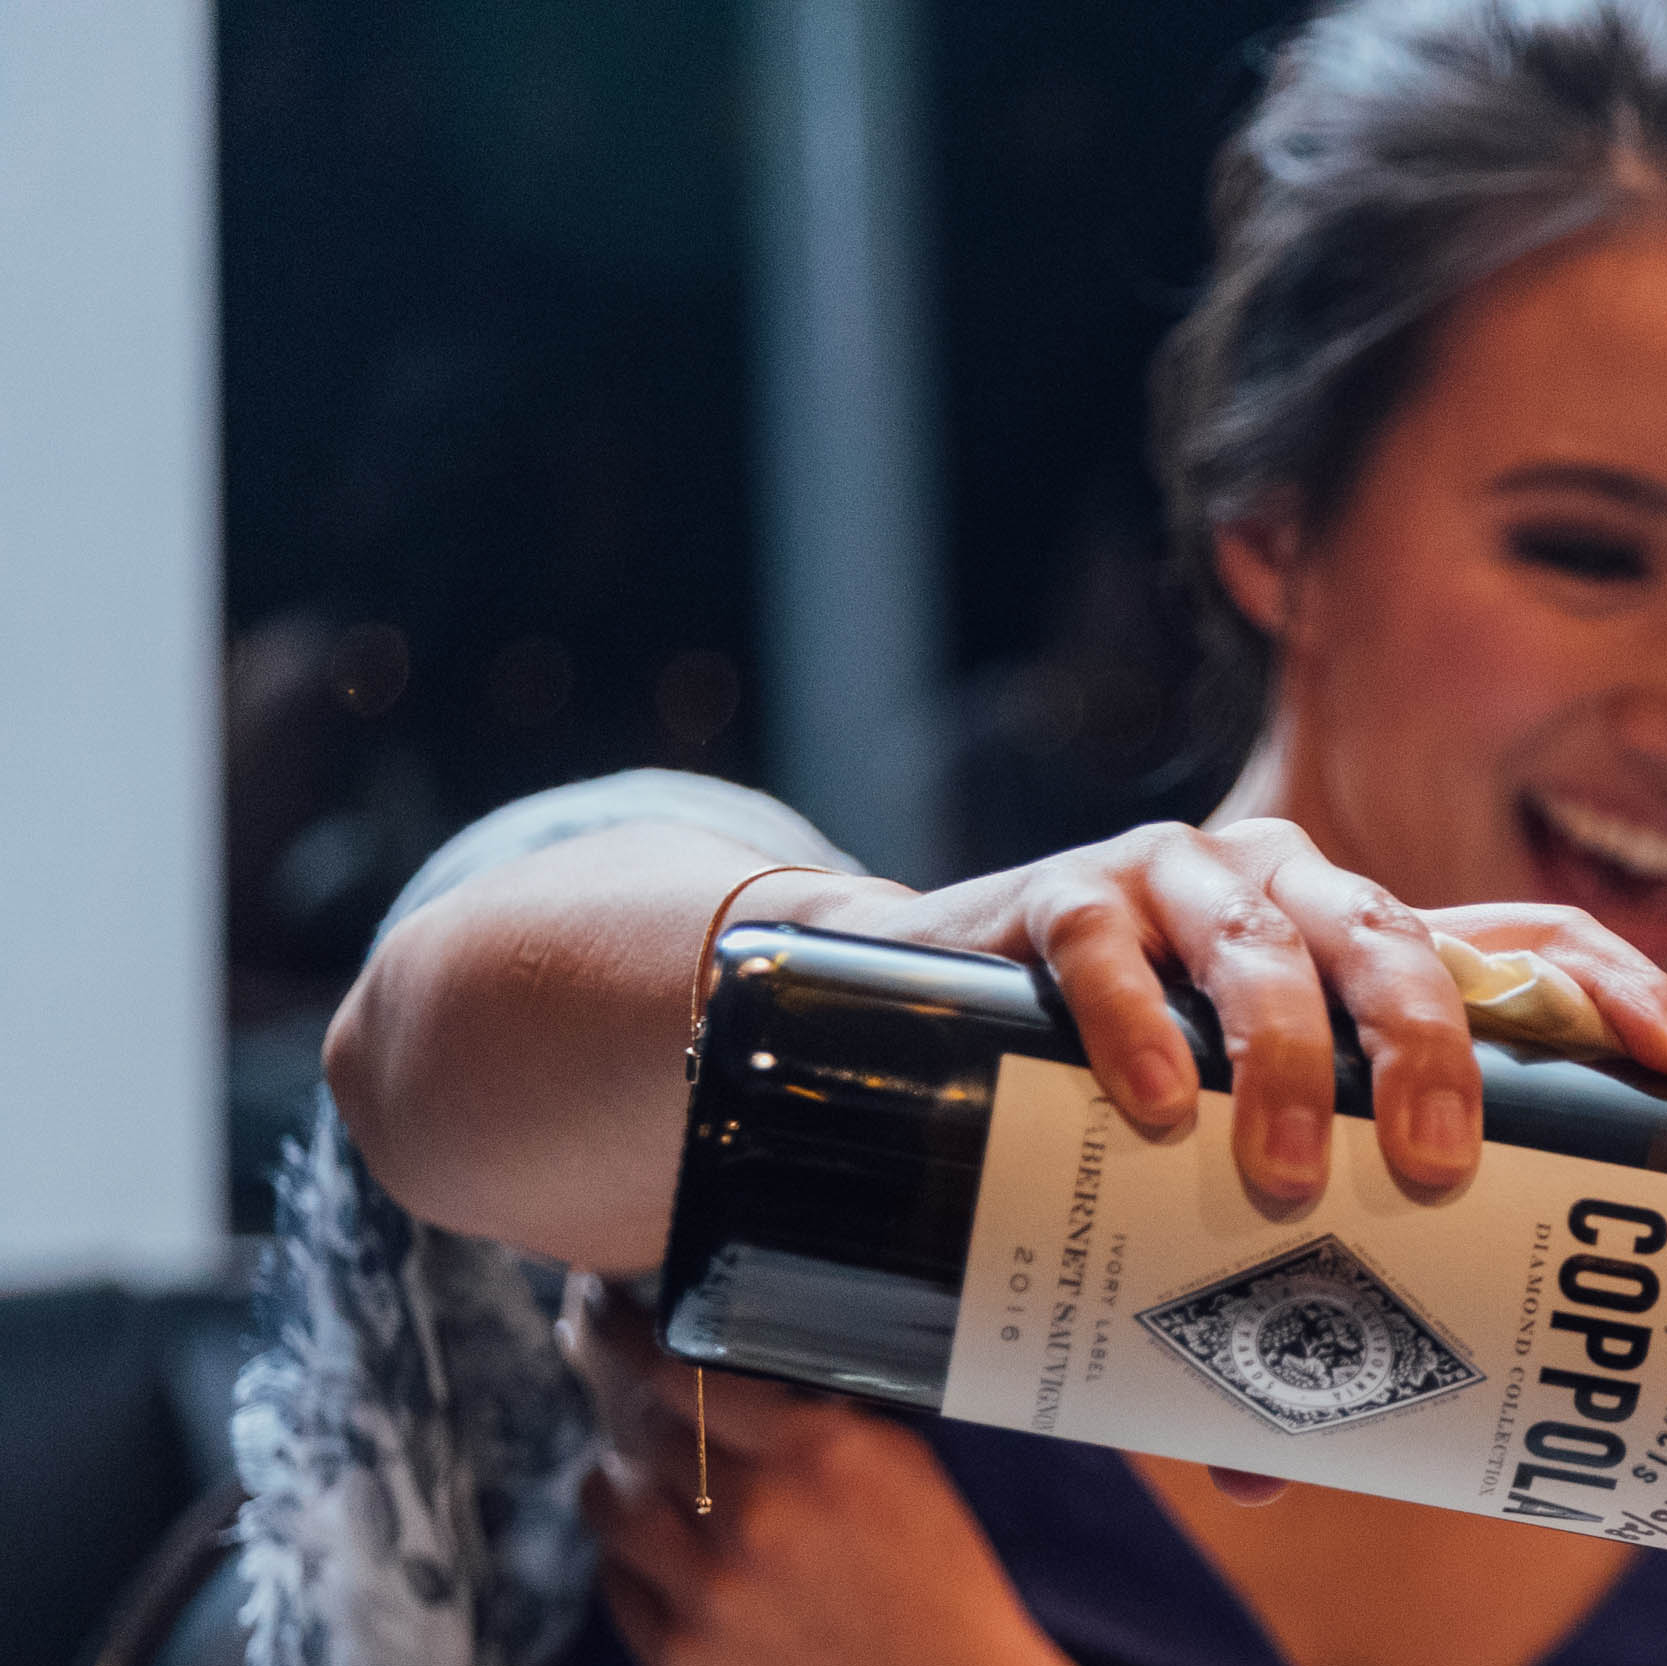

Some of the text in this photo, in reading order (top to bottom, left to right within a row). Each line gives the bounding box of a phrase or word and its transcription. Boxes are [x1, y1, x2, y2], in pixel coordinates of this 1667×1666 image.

[1001, 1245, 1034, 1343] 2016
[1085, 1232, 1127, 1383] IVORY LABEL
[1479, 1222, 1551, 1497] DIAMOND COLLECTION
